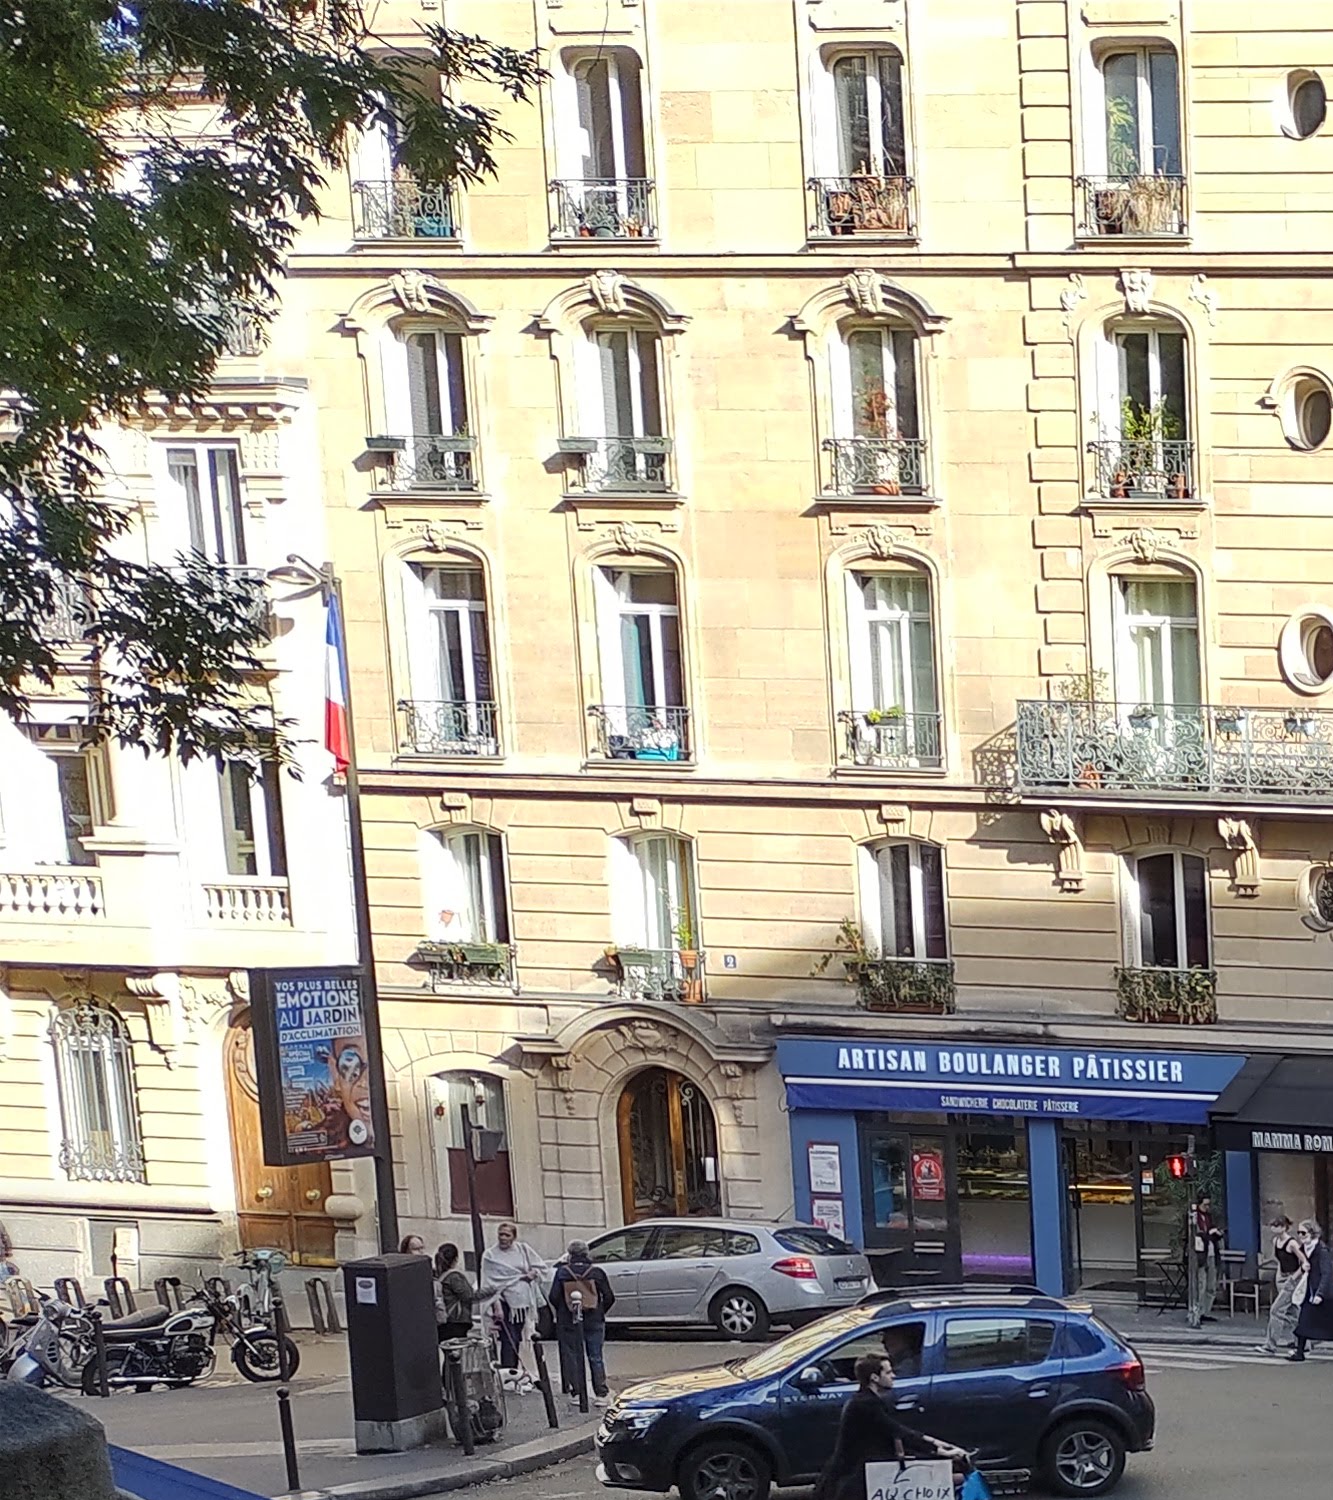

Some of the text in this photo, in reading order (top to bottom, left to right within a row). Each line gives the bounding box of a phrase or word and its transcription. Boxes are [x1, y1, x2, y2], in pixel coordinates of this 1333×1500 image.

[726, 956, 735, 968] 2
[275, 980, 358, 991] VOS PLUS BELLES
[276, 991, 359, 1008] EMOTIONS
[280, 1007, 358, 1027] AU JARDIN
[282, 1026, 360, 1042] D'ACCLIMATATION
[838, 1048, 1183, 1082] ARTISAN BOULANGER PÂTISSIER
[941, 1096, 1079, 1112] SANDWICHERIE CHOCOLATERIE PÂTISSERIE
[1252, 1131, 1302, 1149] MAMMA
[784, 1393, 843, 1402] STEPWAY
